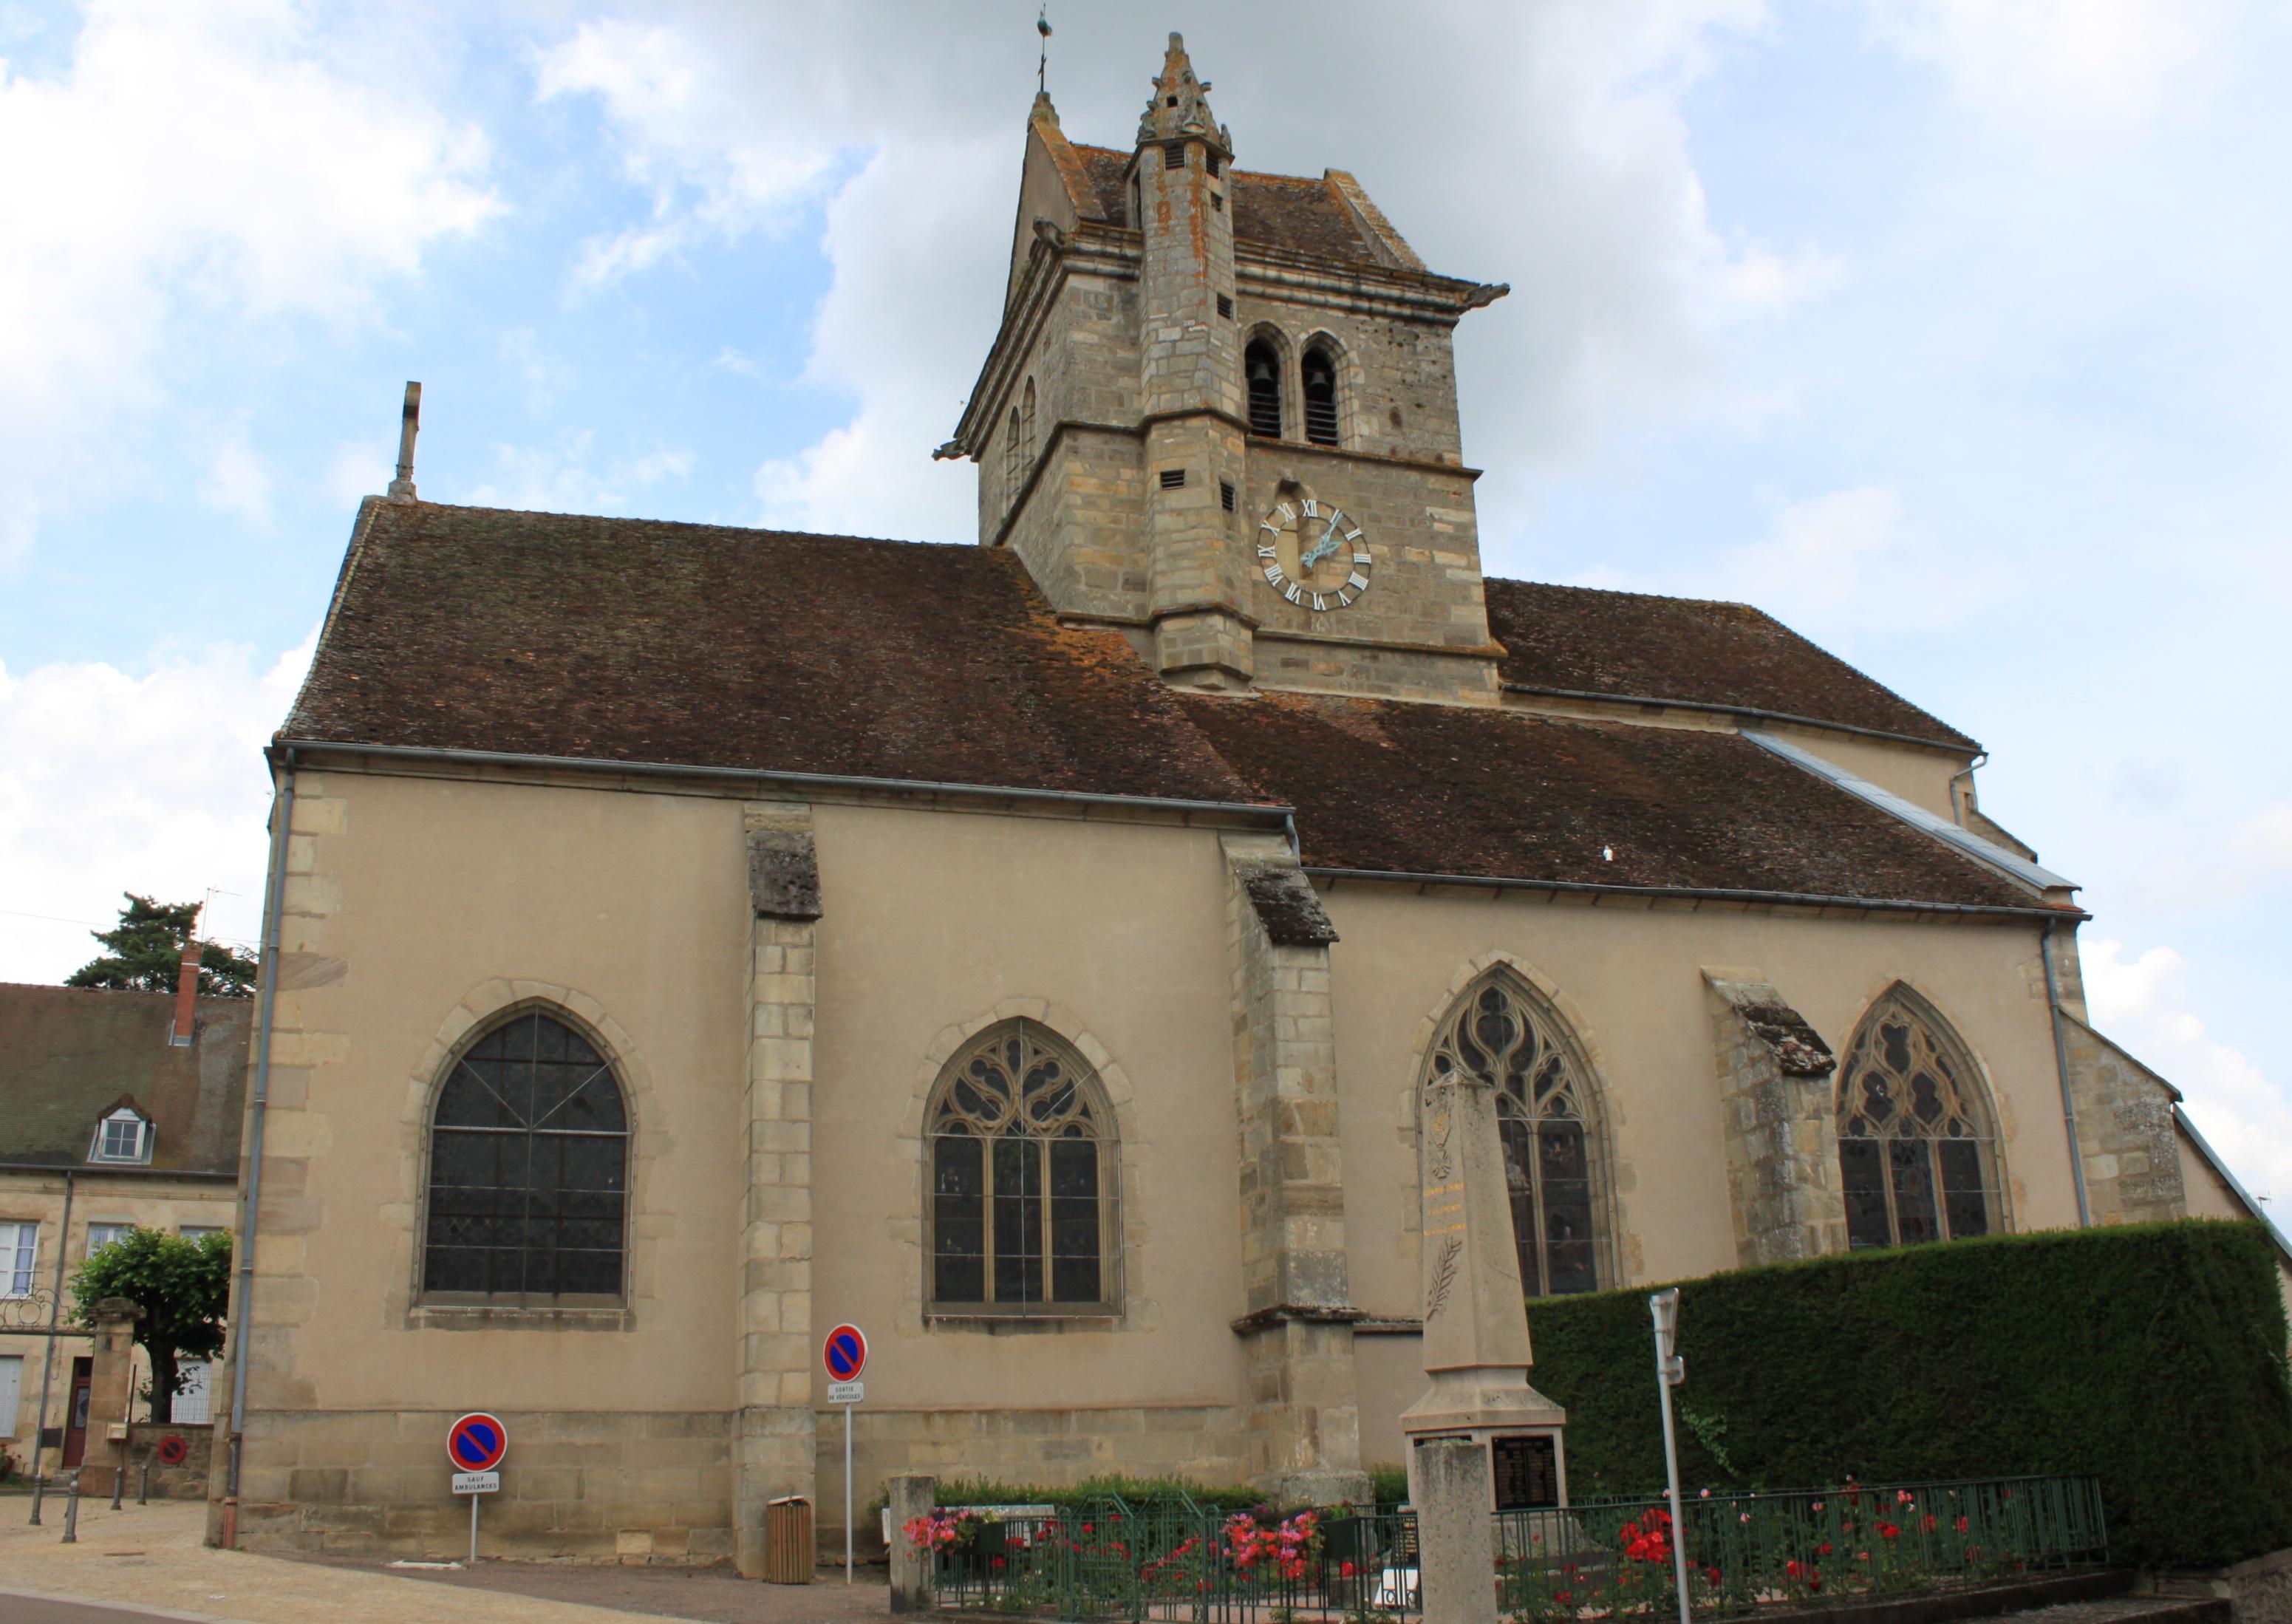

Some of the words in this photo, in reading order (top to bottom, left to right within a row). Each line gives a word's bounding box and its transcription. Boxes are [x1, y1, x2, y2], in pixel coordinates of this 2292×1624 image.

[1278, 502, 1296, 522] XI
[1301, 499, 1318, 517] XII
[1261, 520, 1280, 536] X
[1345, 528, 1362, 541] II
[1257, 545, 1277, 558] IX
[1354, 553, 1371, 564] III
[1264, 563, 1284, 587] VIII
[1285, 582, 1301, 604] VII
[1312, 593, 1326, 610] VI
[1337, 590, 1351, 607] V
